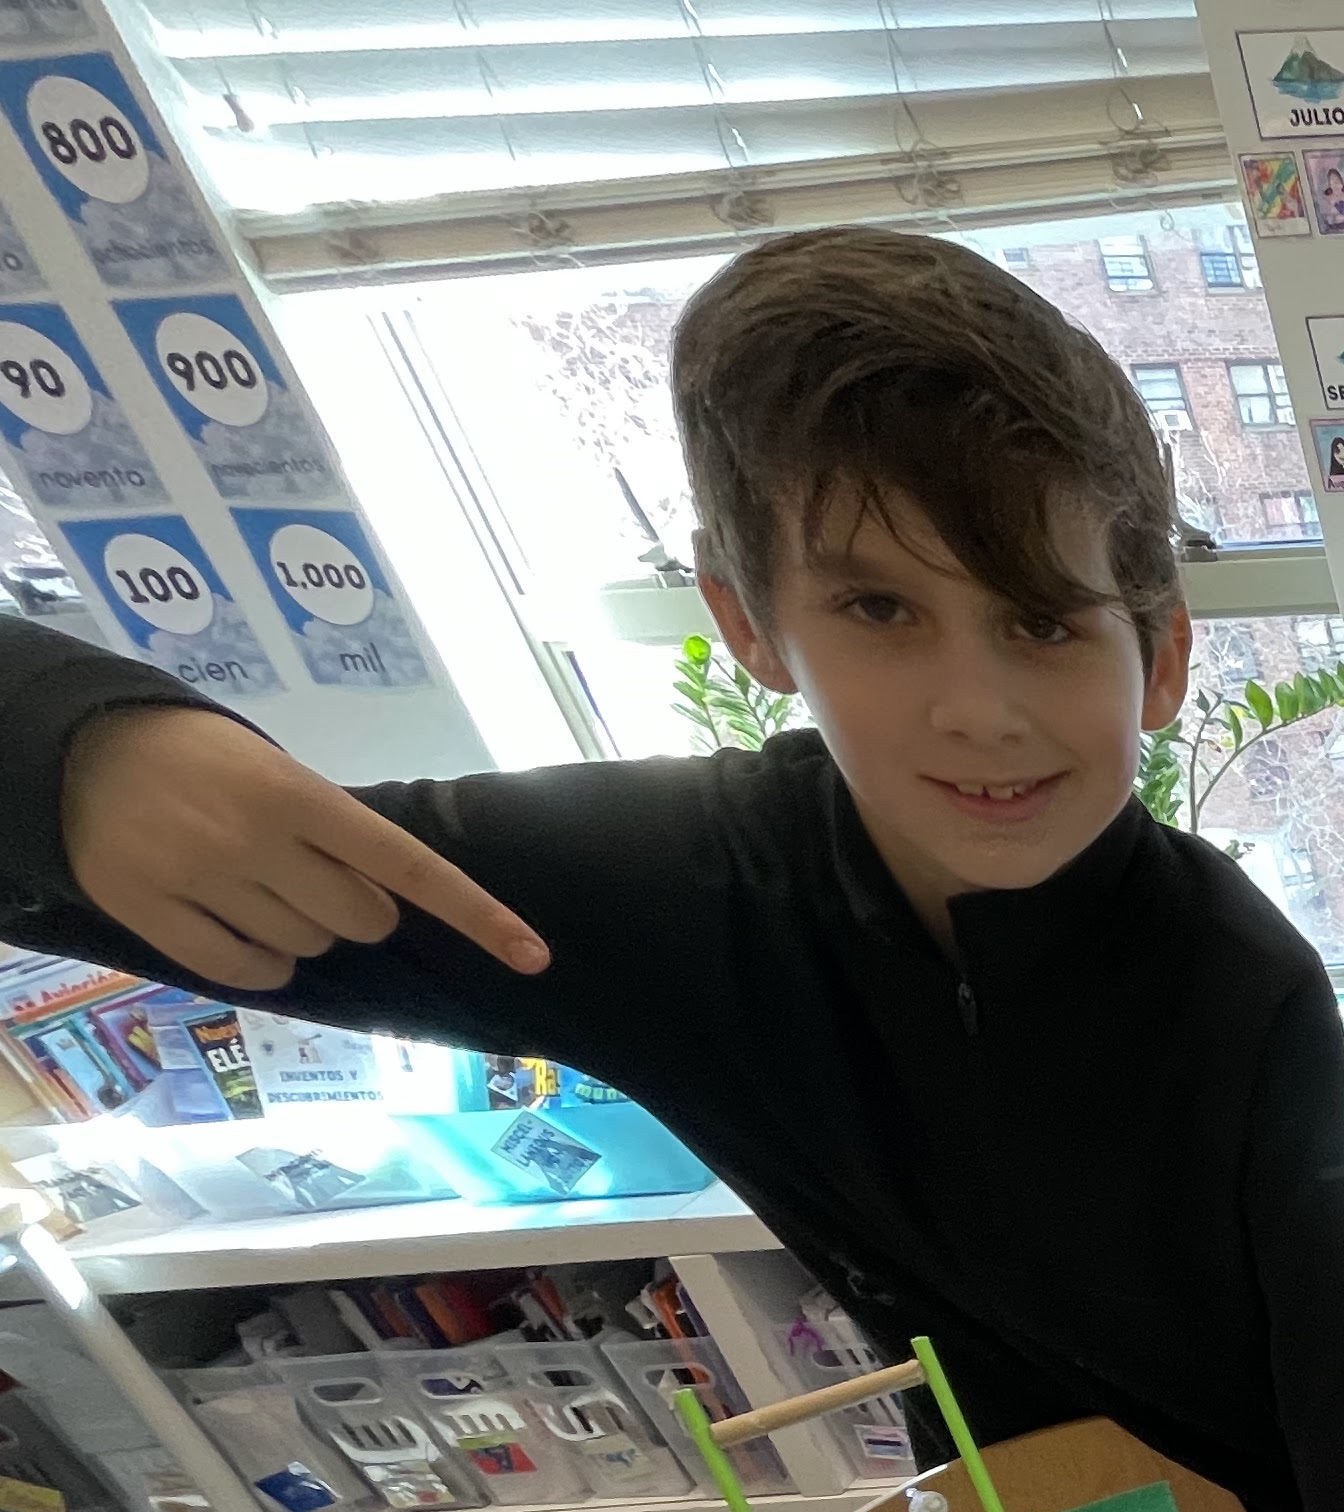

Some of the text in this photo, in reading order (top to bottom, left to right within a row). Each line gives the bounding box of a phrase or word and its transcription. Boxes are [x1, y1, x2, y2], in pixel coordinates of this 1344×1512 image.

[42, 116, 137, 164] 800
[0, 358, 66, 399] 90
[166, 350, 257, 392] 900
[116, 566, 200, 604] 100
[178, 658, 249, 684] cien
[340, 642, 387, 674] mil
[206, 1037, 252, 1074] ELÉ
[279, 1069, 359, 1083] INVENTOS Y
[266, 1088, 385, 1104] DESCUBRIMIENTOS
